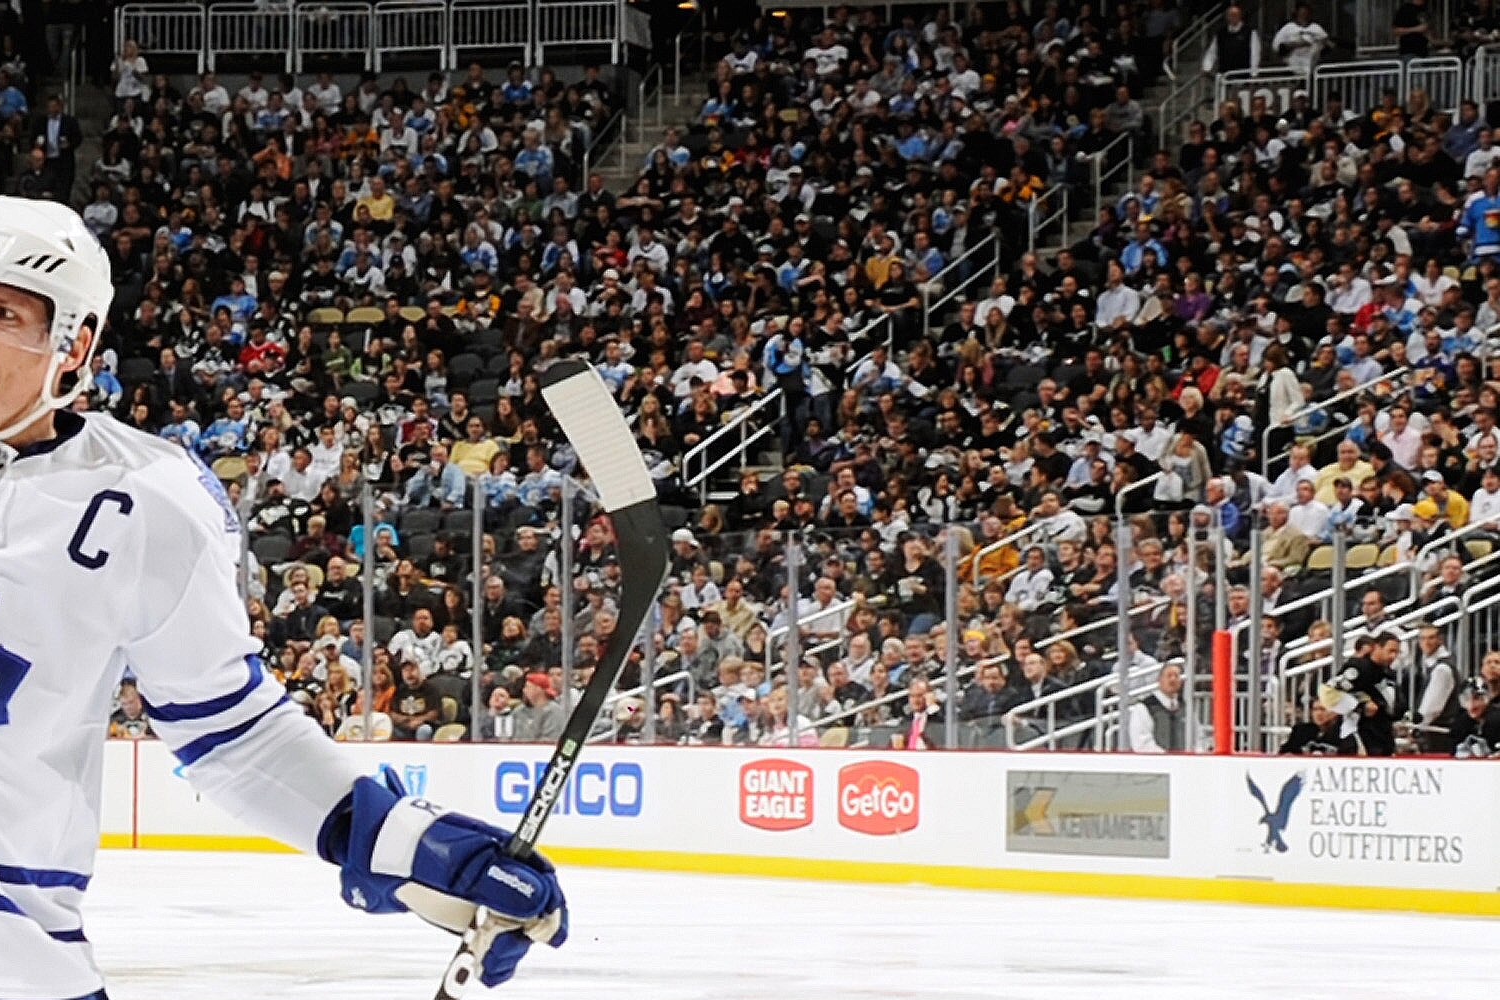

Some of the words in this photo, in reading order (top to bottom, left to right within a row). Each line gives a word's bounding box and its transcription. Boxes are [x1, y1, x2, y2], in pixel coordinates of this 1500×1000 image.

[68, 489, 133, 570] C
[743, 769, 809, 795] GIANT
[1310, 766, 1443, 795] AMERICAN
[746, 795, 807, 820] EAGLE
[841, 783, 915, 819] GetGo
[1309, 798, 1388, 827] EAGLE
[1309, 831, 1464, 864] OUTFITTERS
